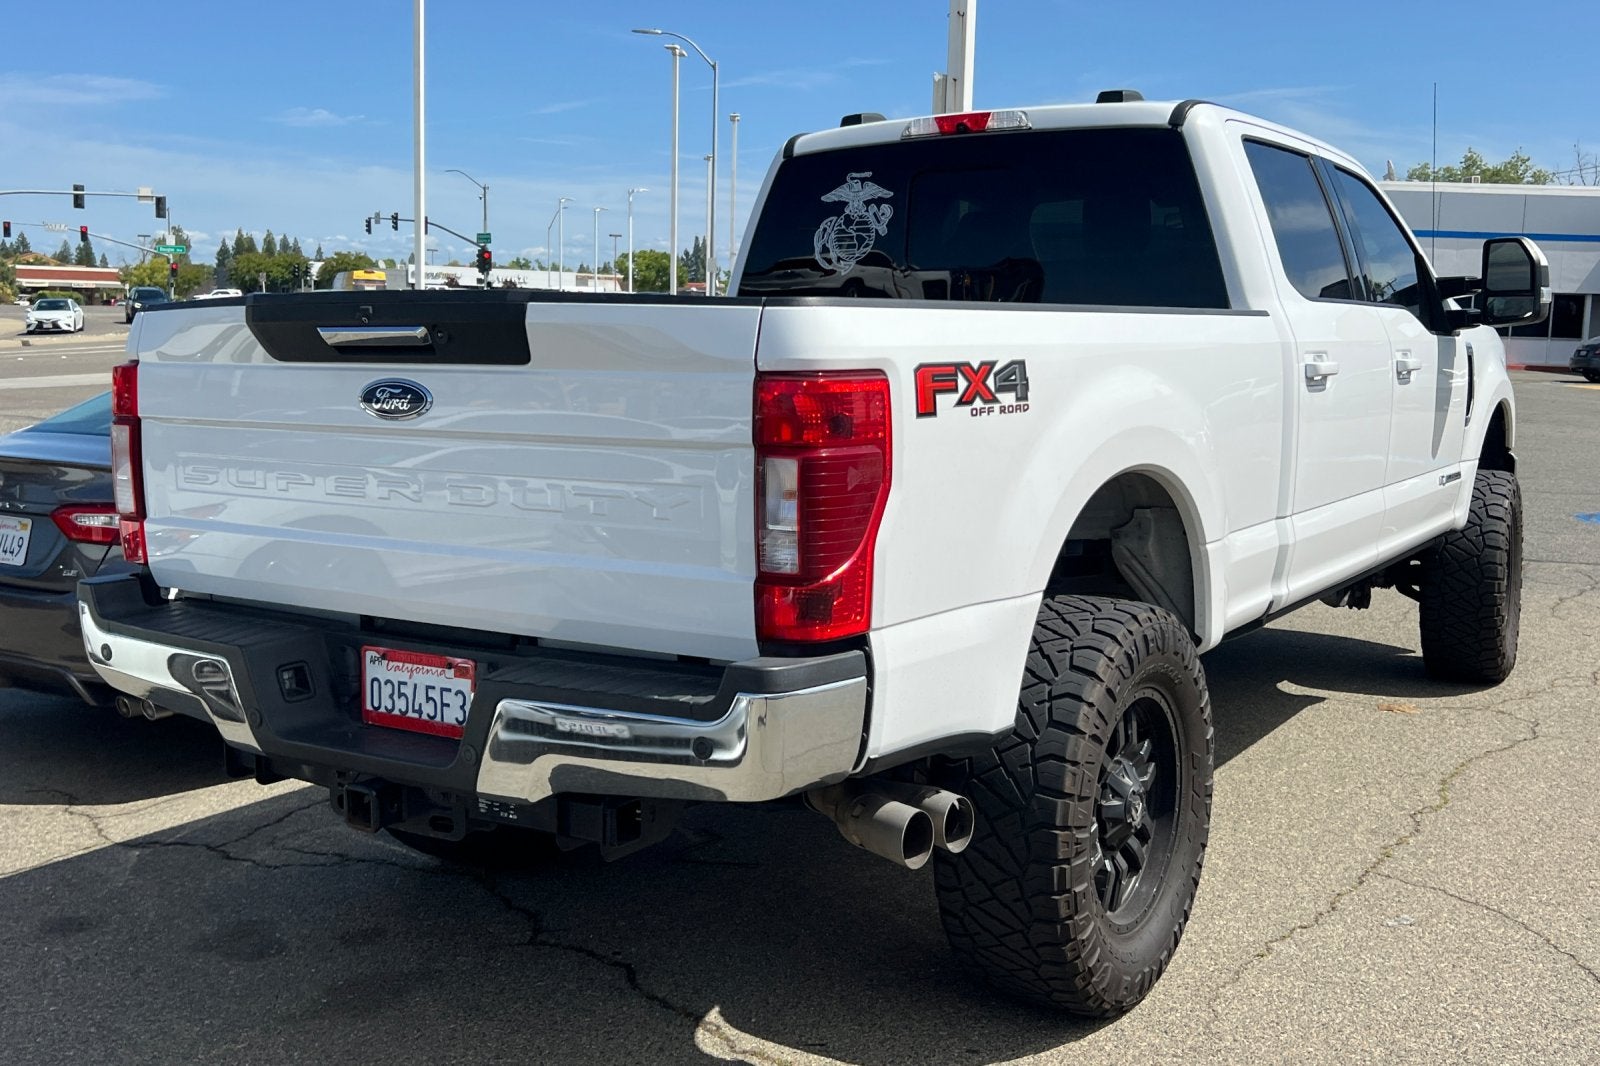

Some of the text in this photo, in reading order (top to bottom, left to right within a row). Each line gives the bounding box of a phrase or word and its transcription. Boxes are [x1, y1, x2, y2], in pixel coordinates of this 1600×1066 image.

[371, 386, 412, 411] Ford
[913, 358, 1030, 420] FX4
[970, 403, 1030, 417] OFF ROAD
[182, 464, 693, 521] SUPER DUTY
[385, 660, 454, 680] California
[370, 676, 467, 726] 03545F3
